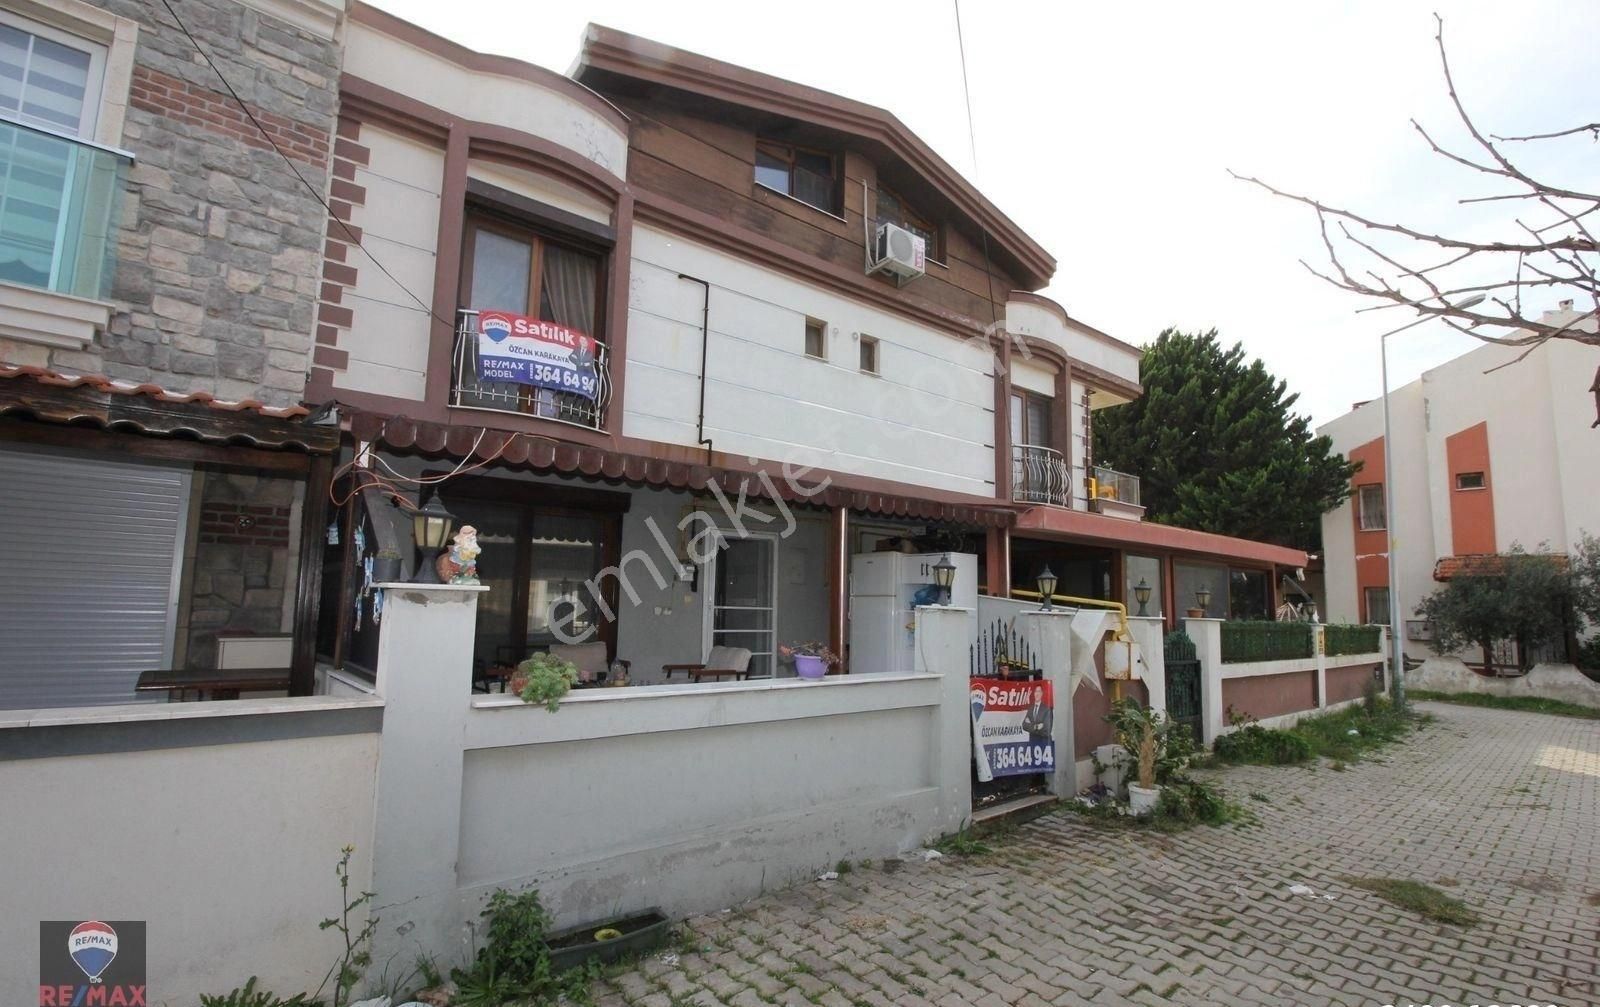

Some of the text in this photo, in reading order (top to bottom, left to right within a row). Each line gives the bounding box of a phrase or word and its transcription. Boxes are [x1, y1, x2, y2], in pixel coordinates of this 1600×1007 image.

[514, 318, 576, 346] Satılık
[508, 344, 570, 364] ÖZCAN KARAKAYA
[483, 360, 525, 370] RE/MAX
[484, 369, 514, 378] MODEL
[534, 364, 561, 384] 364
[563, 370, 581, 389] 64
[581, 376, 595, 394] 94
[988, 686, 1032, 706] Satılık
[996, 747, 1016, 769] 364
[1017, 746, 1033, 767] 64
[1034, 745, 1053, 766] 94
